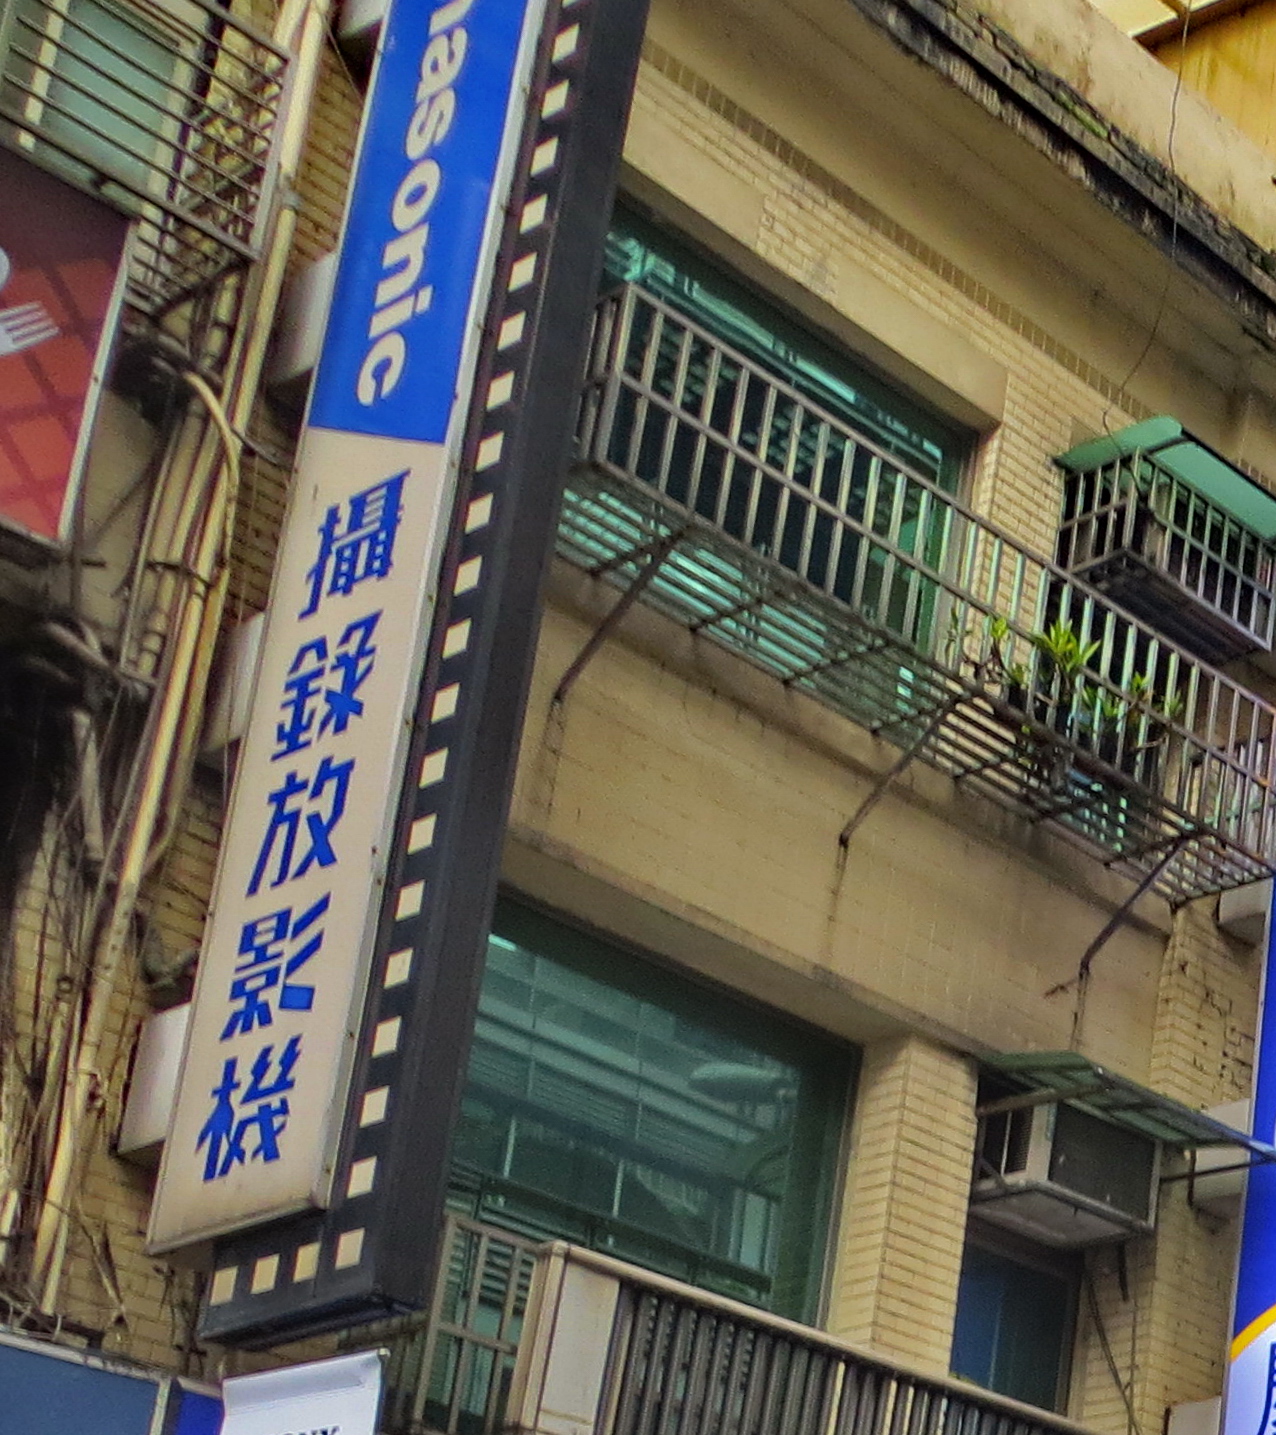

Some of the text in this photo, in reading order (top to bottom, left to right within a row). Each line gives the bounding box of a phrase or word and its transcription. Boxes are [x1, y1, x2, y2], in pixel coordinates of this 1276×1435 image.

[355, 0, 470, 408] asonic
[195, 468, 411, 1182] 攝錄放影機
